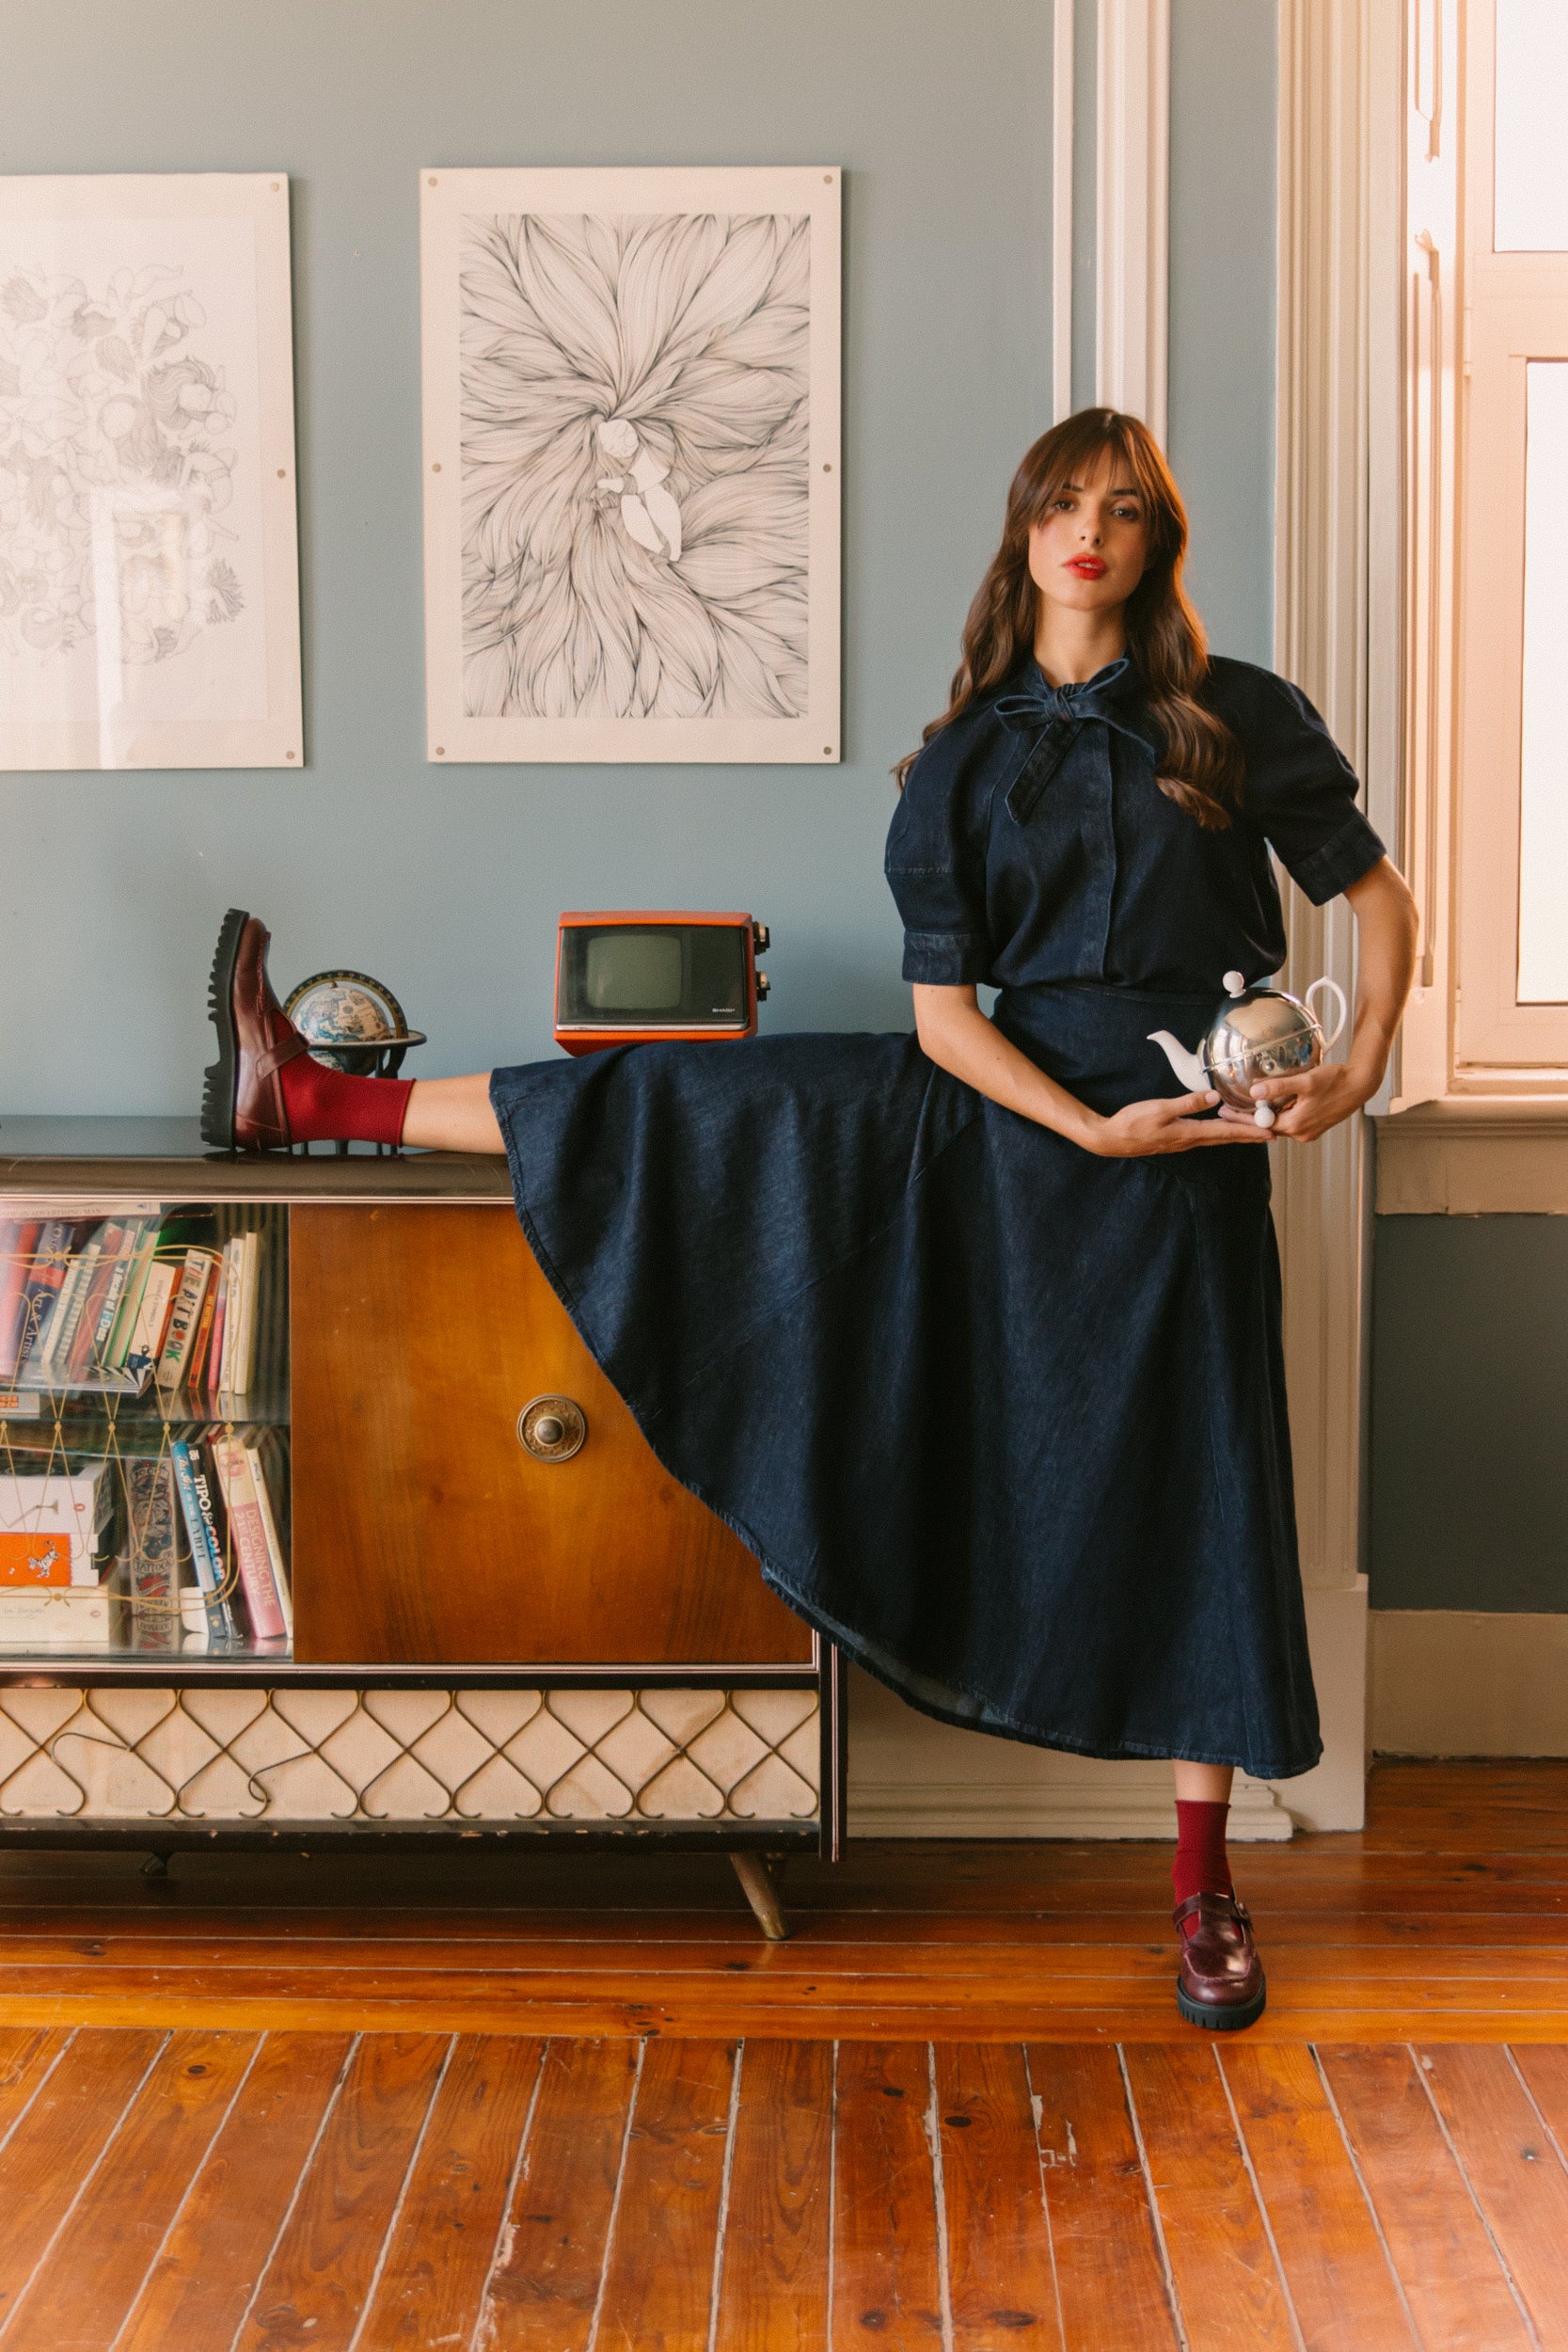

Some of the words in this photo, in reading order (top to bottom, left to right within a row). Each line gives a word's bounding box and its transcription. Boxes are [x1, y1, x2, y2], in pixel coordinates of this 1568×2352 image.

[182, 1257, 206, 1287] THE
[32, 1287, 49, 1310] Art
[176, 1288, 198, 1318] ART
[20, 1326, 38, 1364] Artists
[164, 1318, 190, 1362] BOOK
[190, 1518, 207, 1562] LABEL
[195, 1473, 212, 1511] TIPO
[205, 1525, 226, 1581] COLOR
[240, 1536, 261, 1597] CENTURY
[246, 1509, 272, 1581] DESIGNING
[259, 1581, 276, 1608] THE
